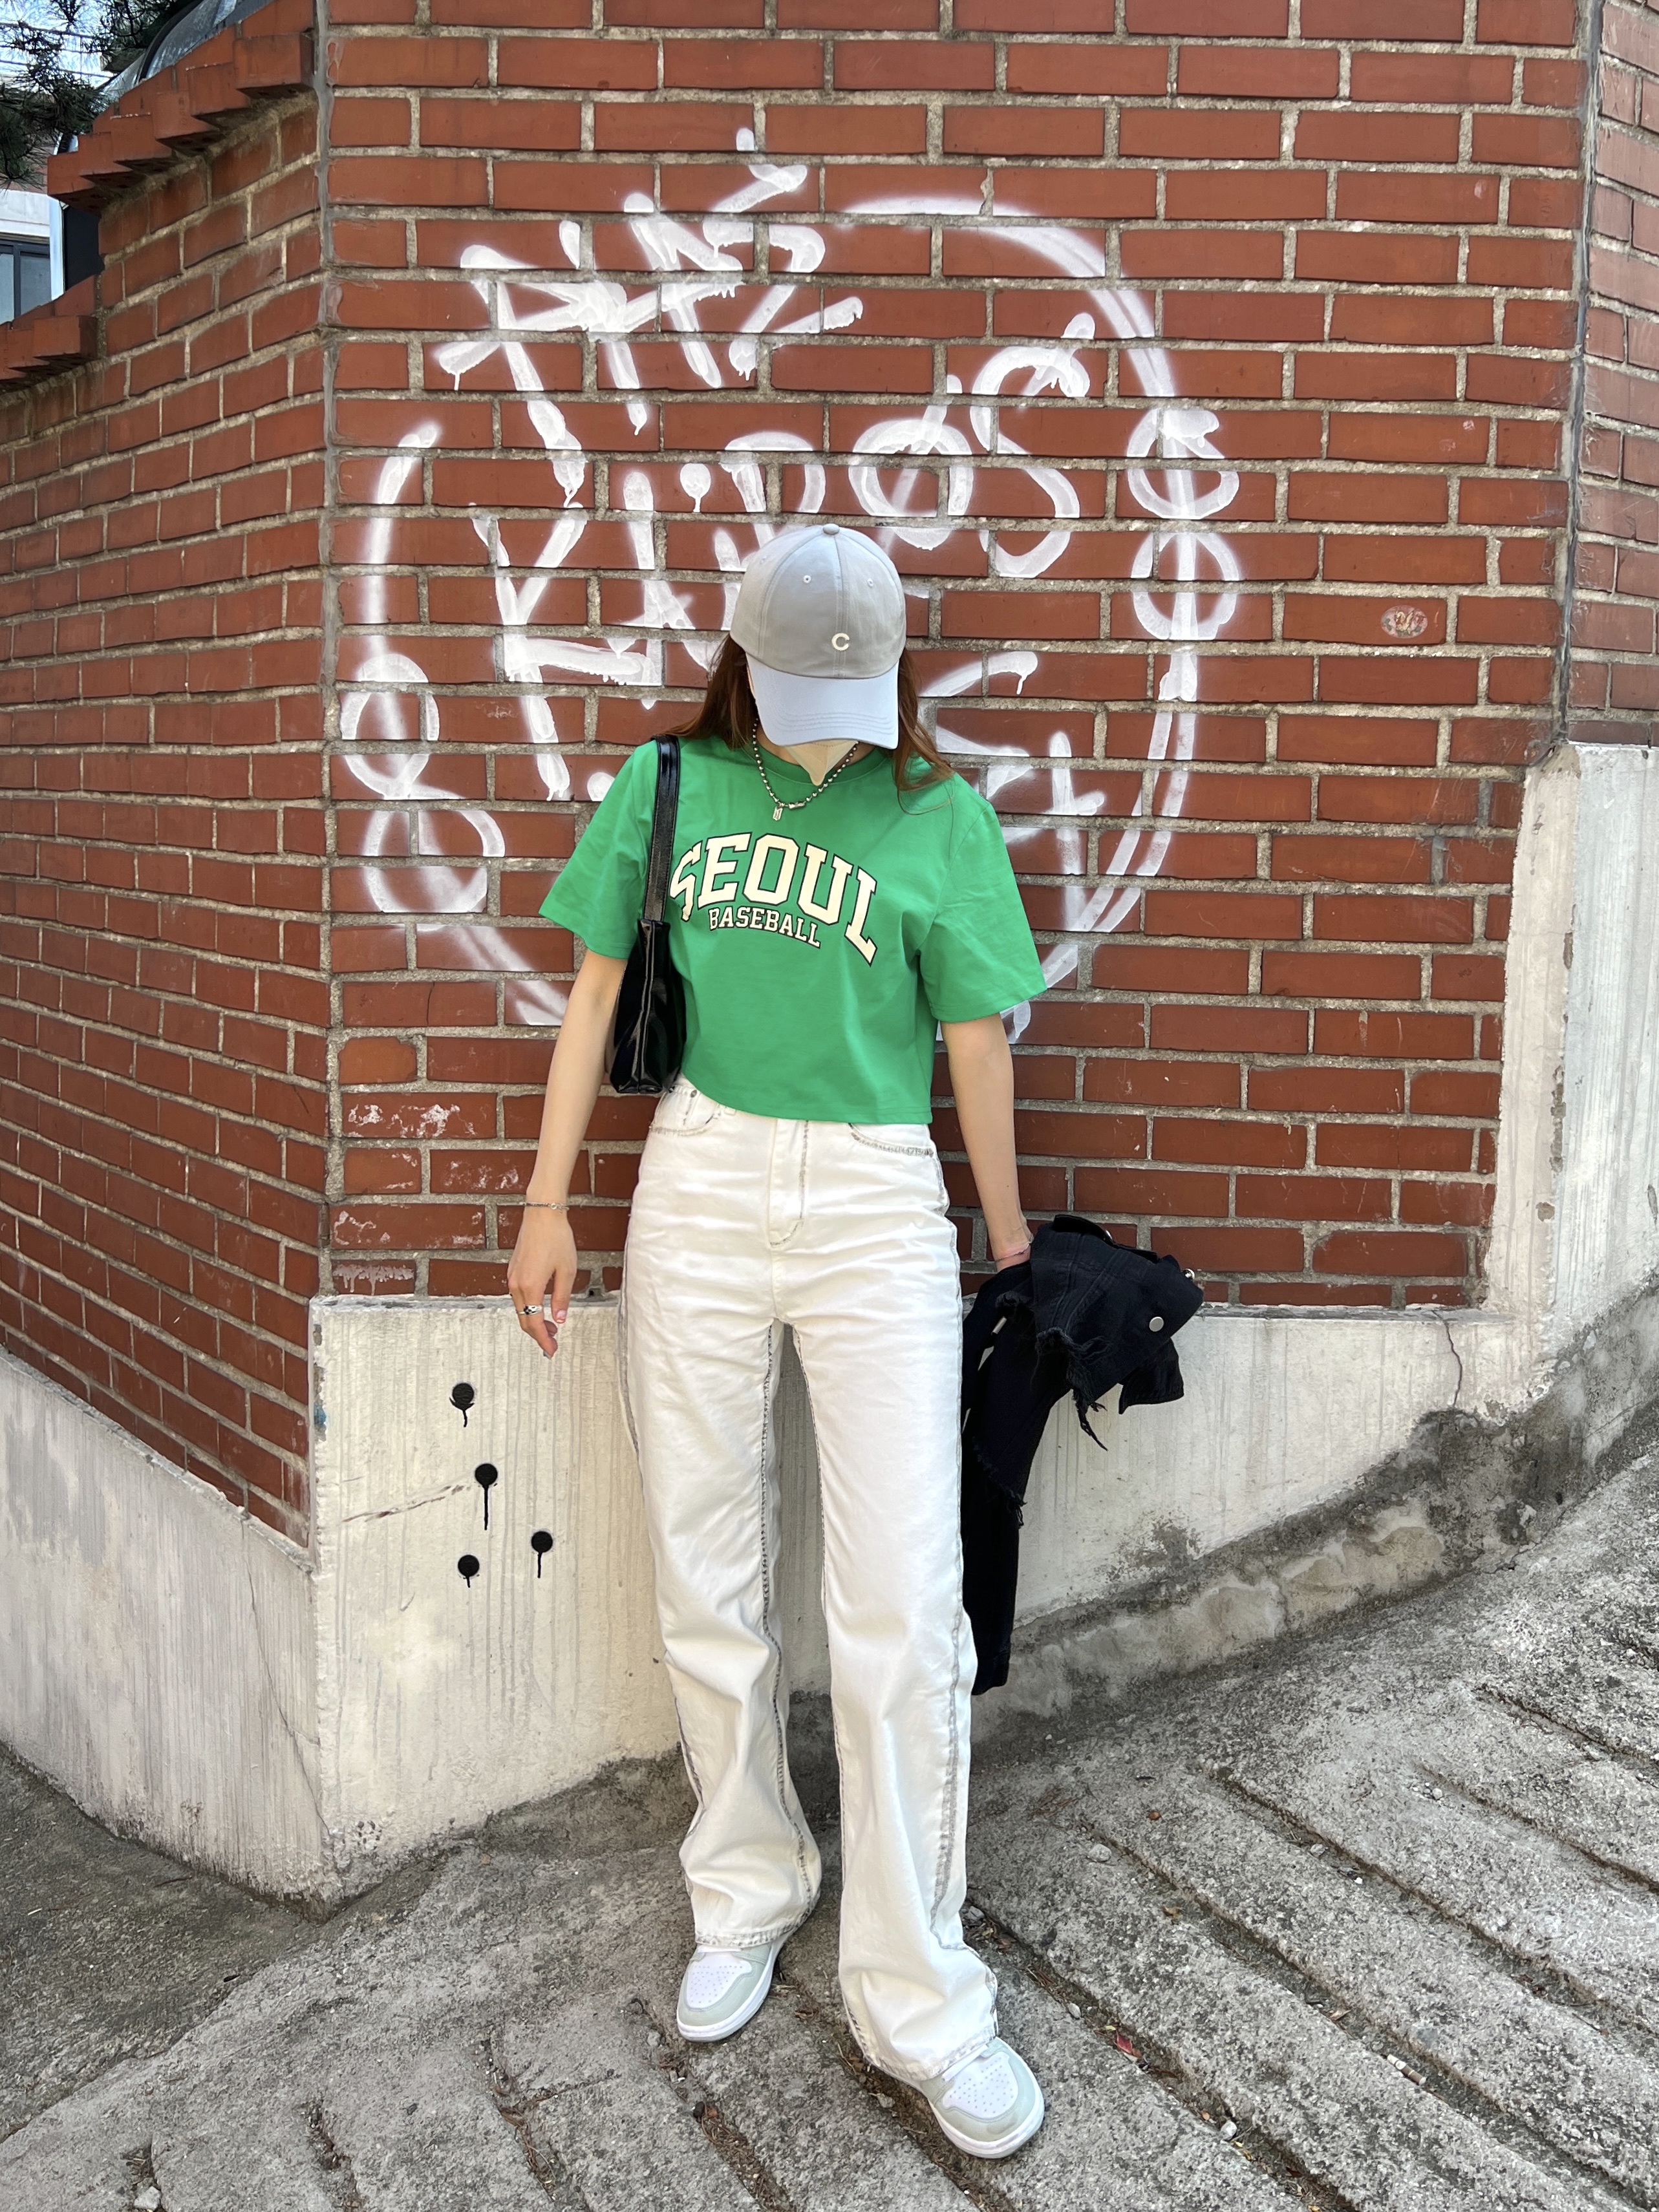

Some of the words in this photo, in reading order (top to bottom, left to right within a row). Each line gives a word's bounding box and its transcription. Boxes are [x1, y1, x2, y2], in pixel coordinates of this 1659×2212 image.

[831, 632, 850, 651] C
[669, 832, 878, 967] SEOUL
[709, 906, 821, 949] BASEBALL
